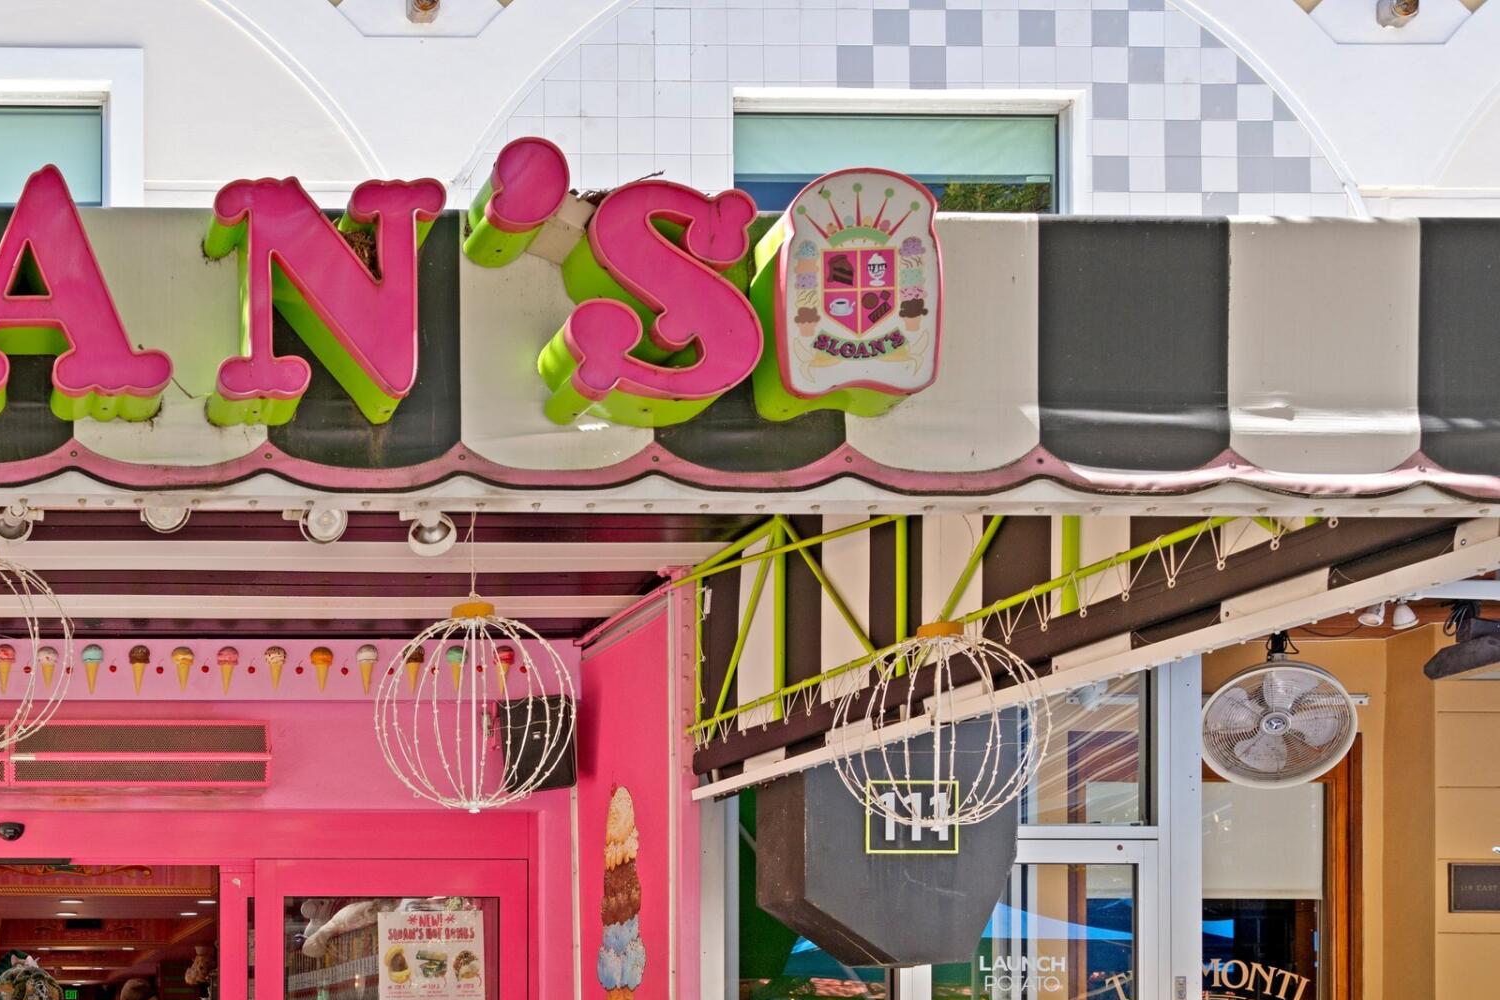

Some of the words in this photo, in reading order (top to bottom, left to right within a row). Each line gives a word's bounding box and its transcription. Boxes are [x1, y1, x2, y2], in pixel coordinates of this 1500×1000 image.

[813, 329, 906, 359] SLOAN'S
[878, 792, 949, 841] 111
[979, 955, 1066, 972] LAUNCH
[984, 975, 1061, 993] POTATO
